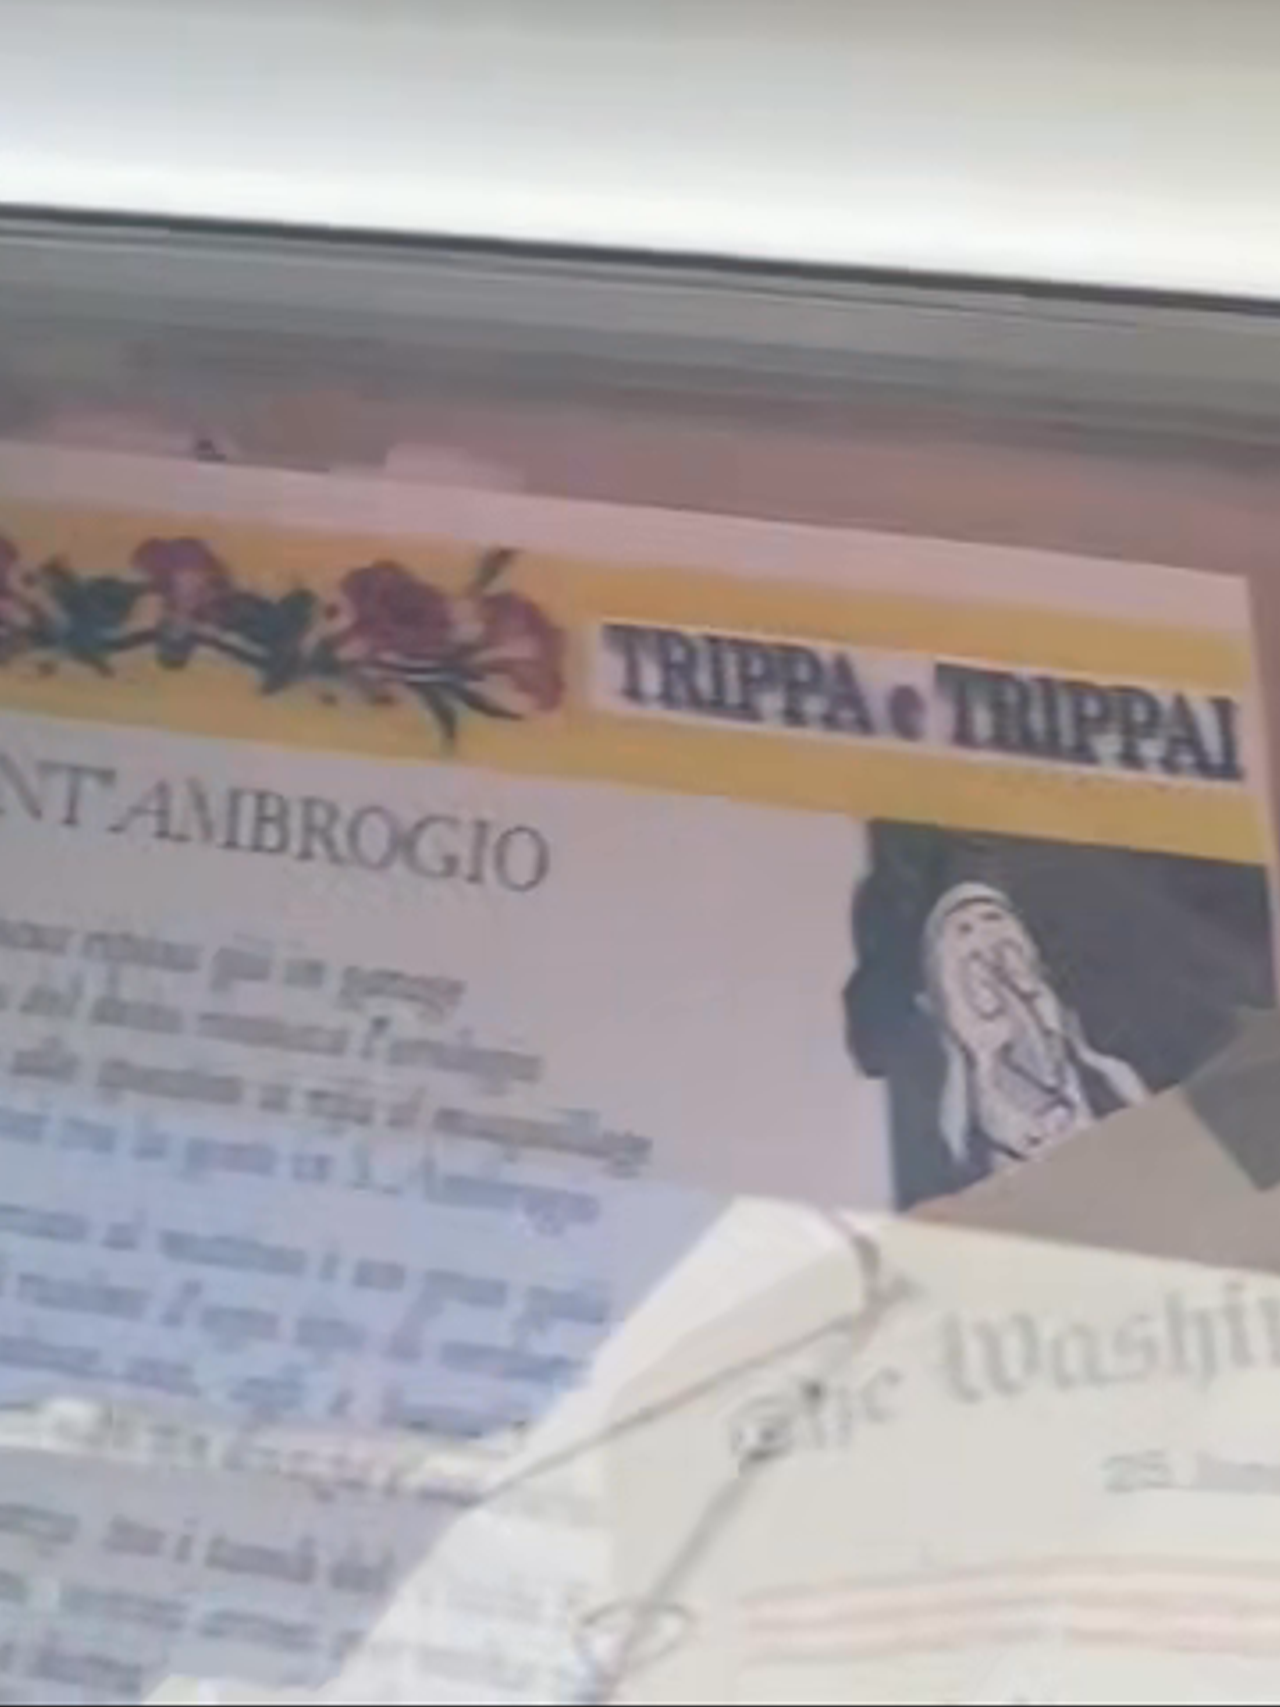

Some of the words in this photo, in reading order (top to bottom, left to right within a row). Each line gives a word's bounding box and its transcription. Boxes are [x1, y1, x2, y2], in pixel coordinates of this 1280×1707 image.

[599, 621, 877, 737] TRIPPA
[886, 683, 926, 744] e
[932, 660, 1247, 782] TRIPPAI
